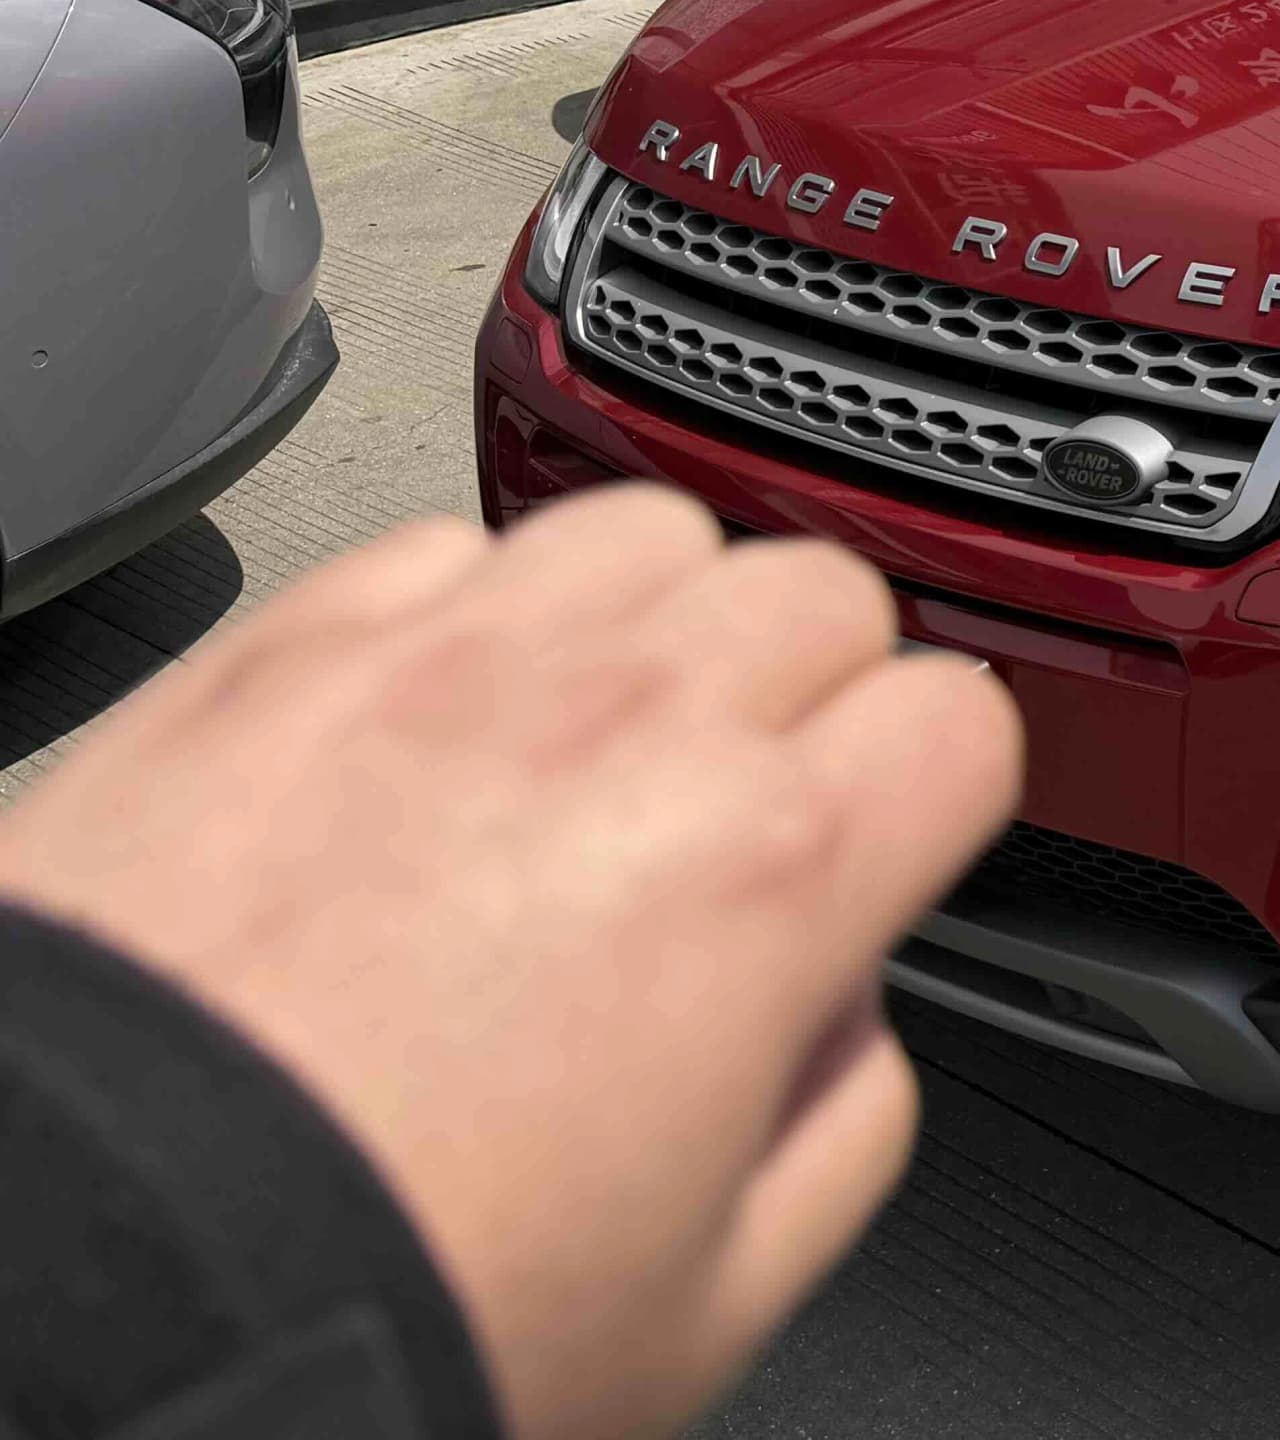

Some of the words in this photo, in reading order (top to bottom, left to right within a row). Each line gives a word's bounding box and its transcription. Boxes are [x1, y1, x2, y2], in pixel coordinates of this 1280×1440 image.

[638, 119, 895, 231] RANGE
[1063, 447, 1109, 471] LAND
[1066, 466, 1123, 491] ROVER
